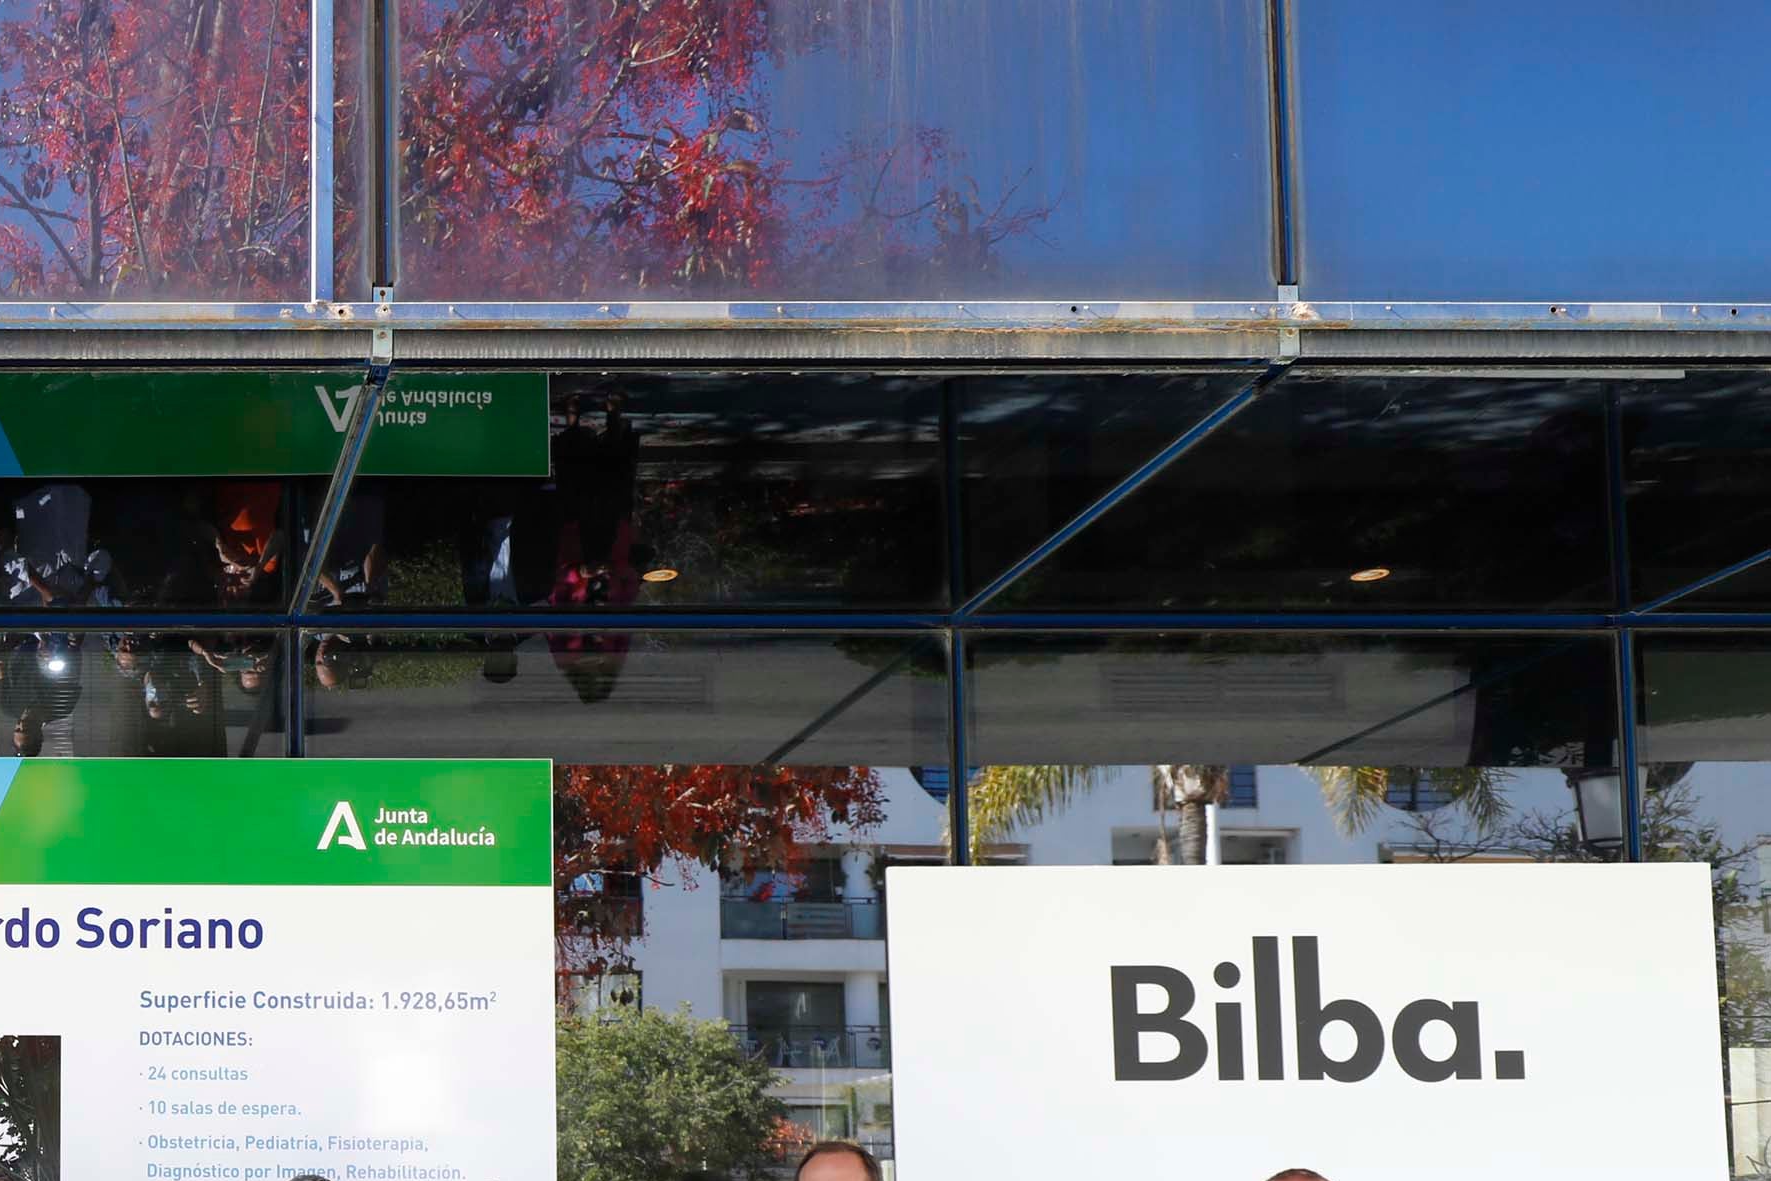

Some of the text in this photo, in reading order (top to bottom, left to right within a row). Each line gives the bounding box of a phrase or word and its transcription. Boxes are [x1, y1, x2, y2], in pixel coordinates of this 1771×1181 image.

[374, 807, 428, 825] Junta
[374, 826, 496, 848] de Andalucía
[75, 907, 264, 950] Soriano
[139, 990, 247, 1014] Superficie
[253, 990, 374, 1010] Construida:
[1110, 935, 1526, 1083] Bilba.
[139, 1031, 253, 1047] DOTACIONES:
[147, 1065, 249, 1081] 24 consultas
[148, 1100, 302, 1119] 10 salas de espera.
[147, 1134, 429, 1154] Obstetricia, Pediatría, Fisioterapia,
[147, 1162, 240, 1181] Diagnóstico
[244, 1167, 271, 1181] por
[345, 1162, 467, 1181] Rehabilitación.
